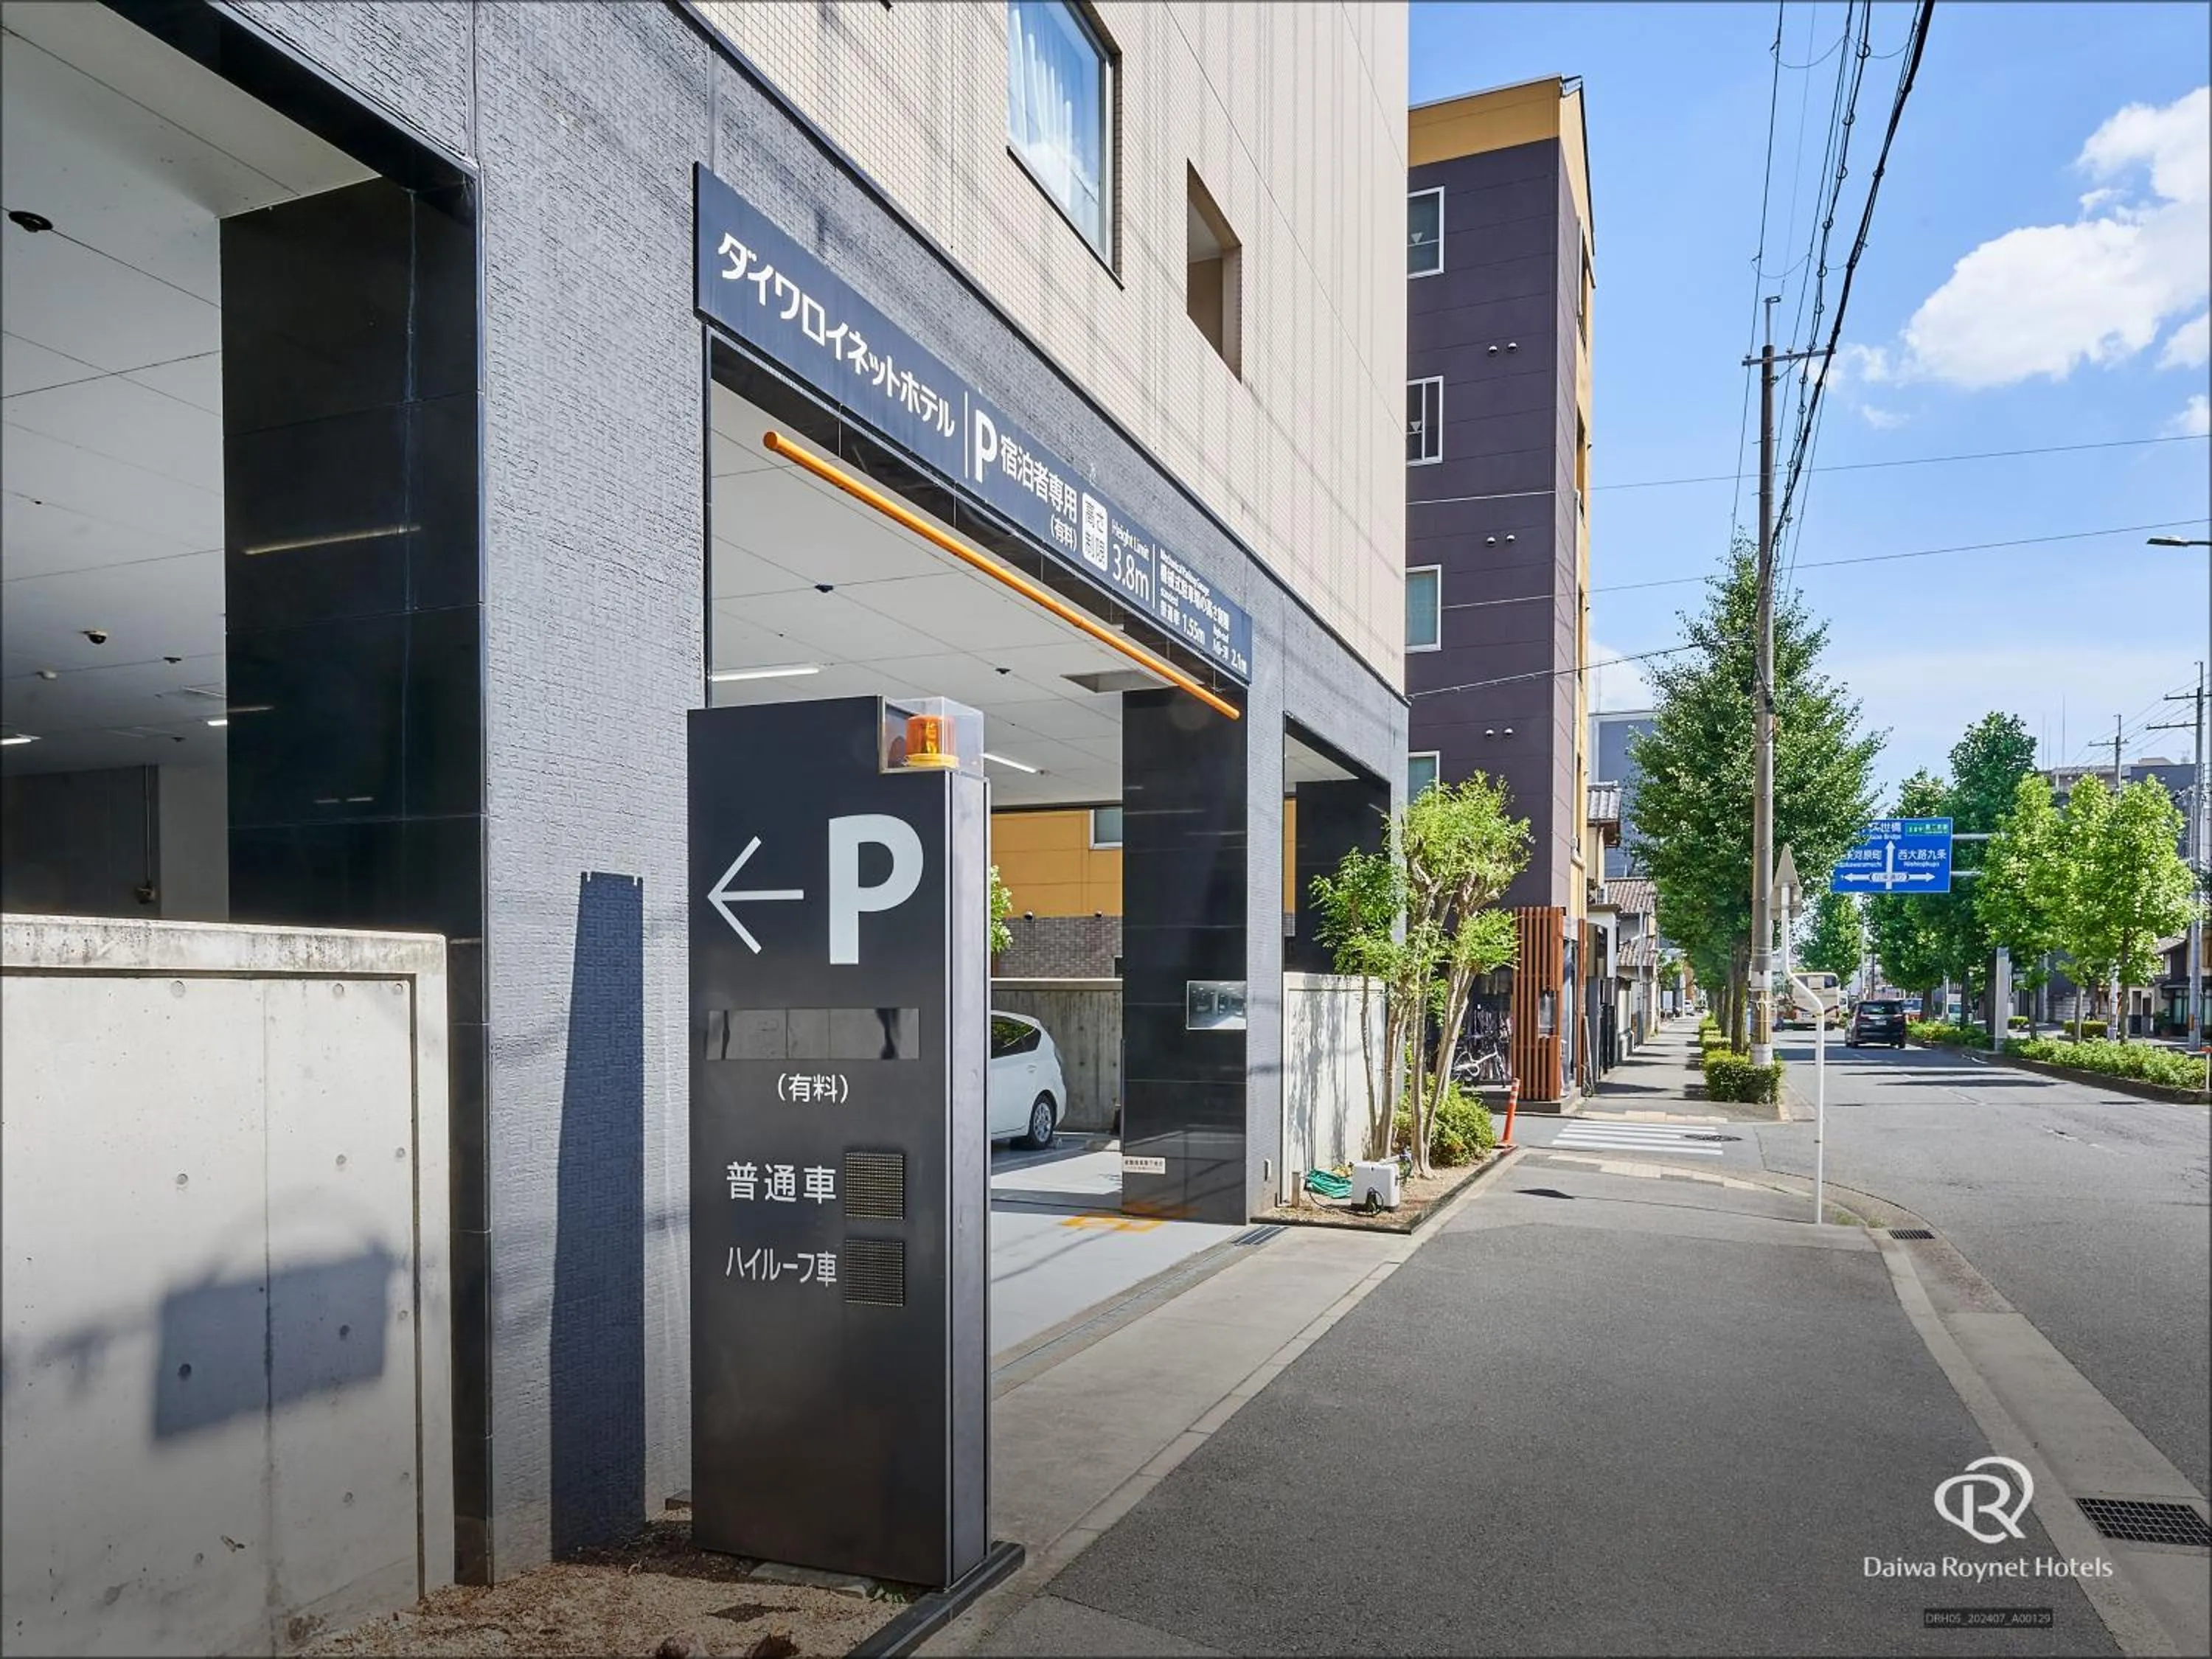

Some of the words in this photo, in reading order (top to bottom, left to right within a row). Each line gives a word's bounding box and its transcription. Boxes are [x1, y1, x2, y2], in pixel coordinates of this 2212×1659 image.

[717, 232, 956, 438] ダイワロイネットホテル
[975, 408, 998, 484] P
[1000, 436, 1078, 524] 宿泊者専用
[1113, 543, 1150, 602] 3.8m
[1897, 848, 1947, 861] 西大路九条
[827, 813, 925, 966] P
[777, 1073, 849, 1104] (有料)
[726, 1161, 838, 1206] 普通車
[725, 1245, 838, 1289] ハイルーフ車
